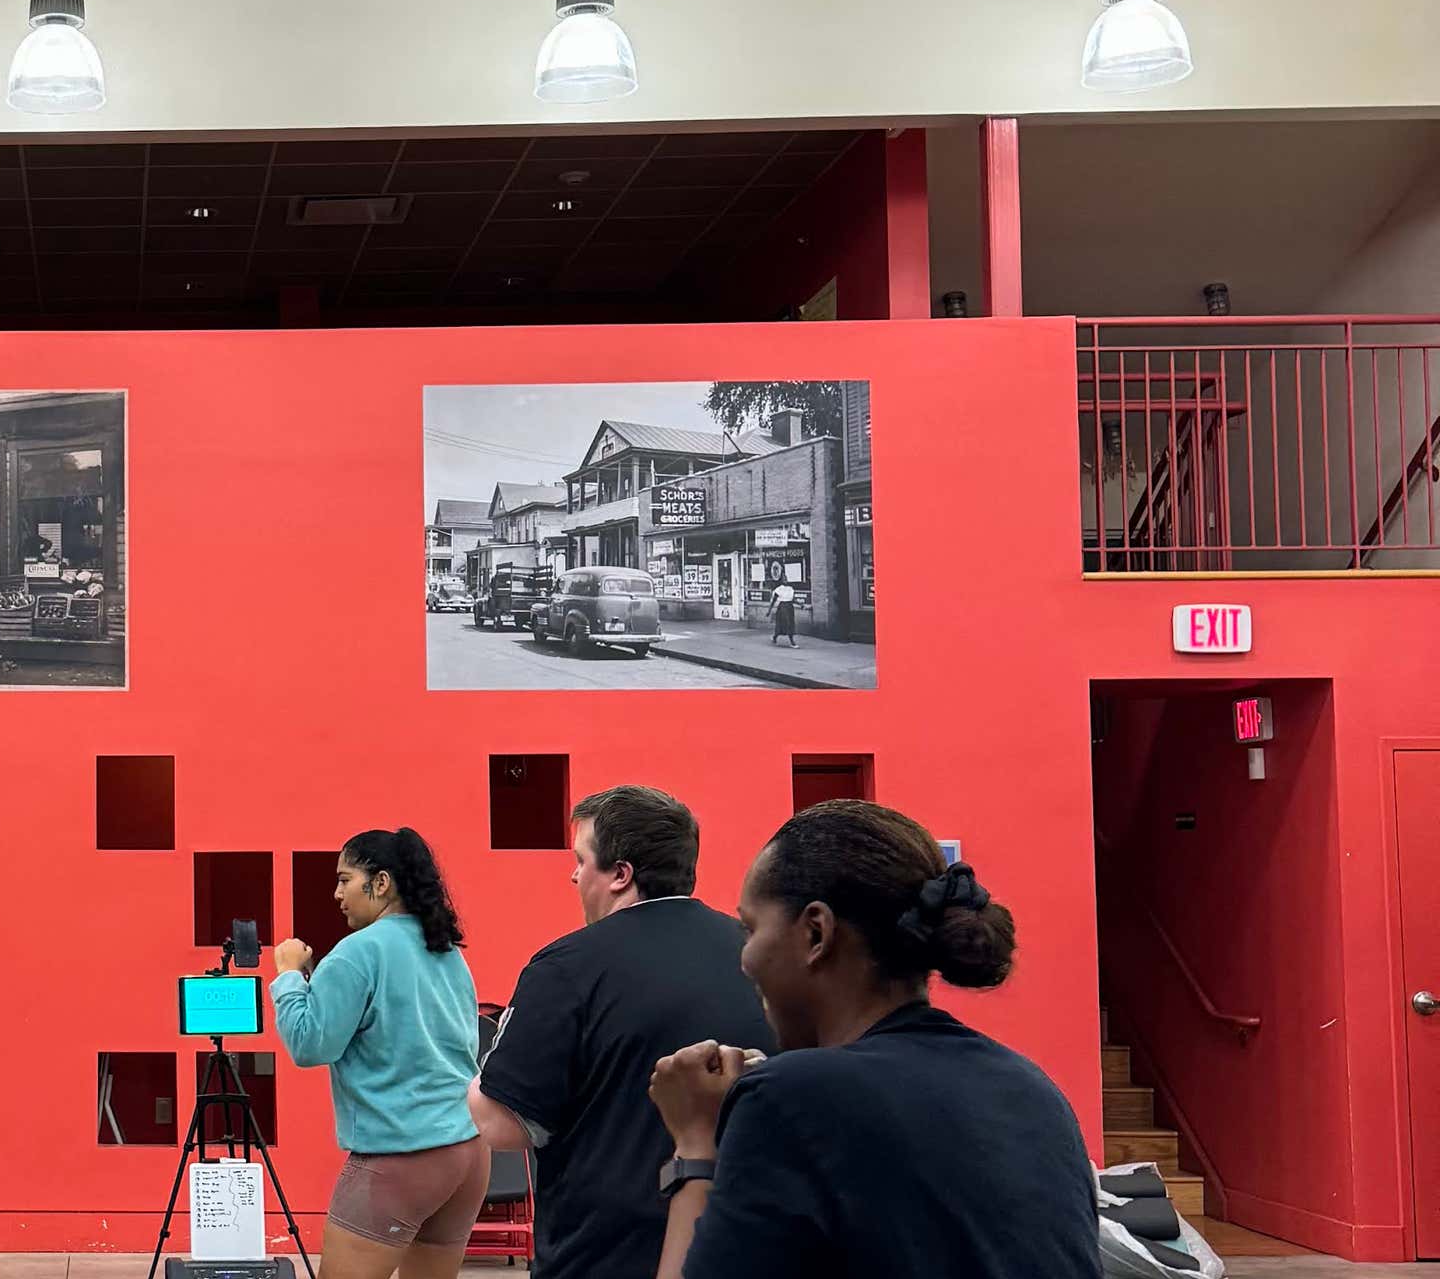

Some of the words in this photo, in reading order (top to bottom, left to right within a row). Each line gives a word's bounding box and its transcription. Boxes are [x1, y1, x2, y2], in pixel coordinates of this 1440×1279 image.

[660, 514, 705, 523] GROCERIES
[1189, 608, 1242, 648] EXIT
[1236, 700, 1259, 739] EXIT
